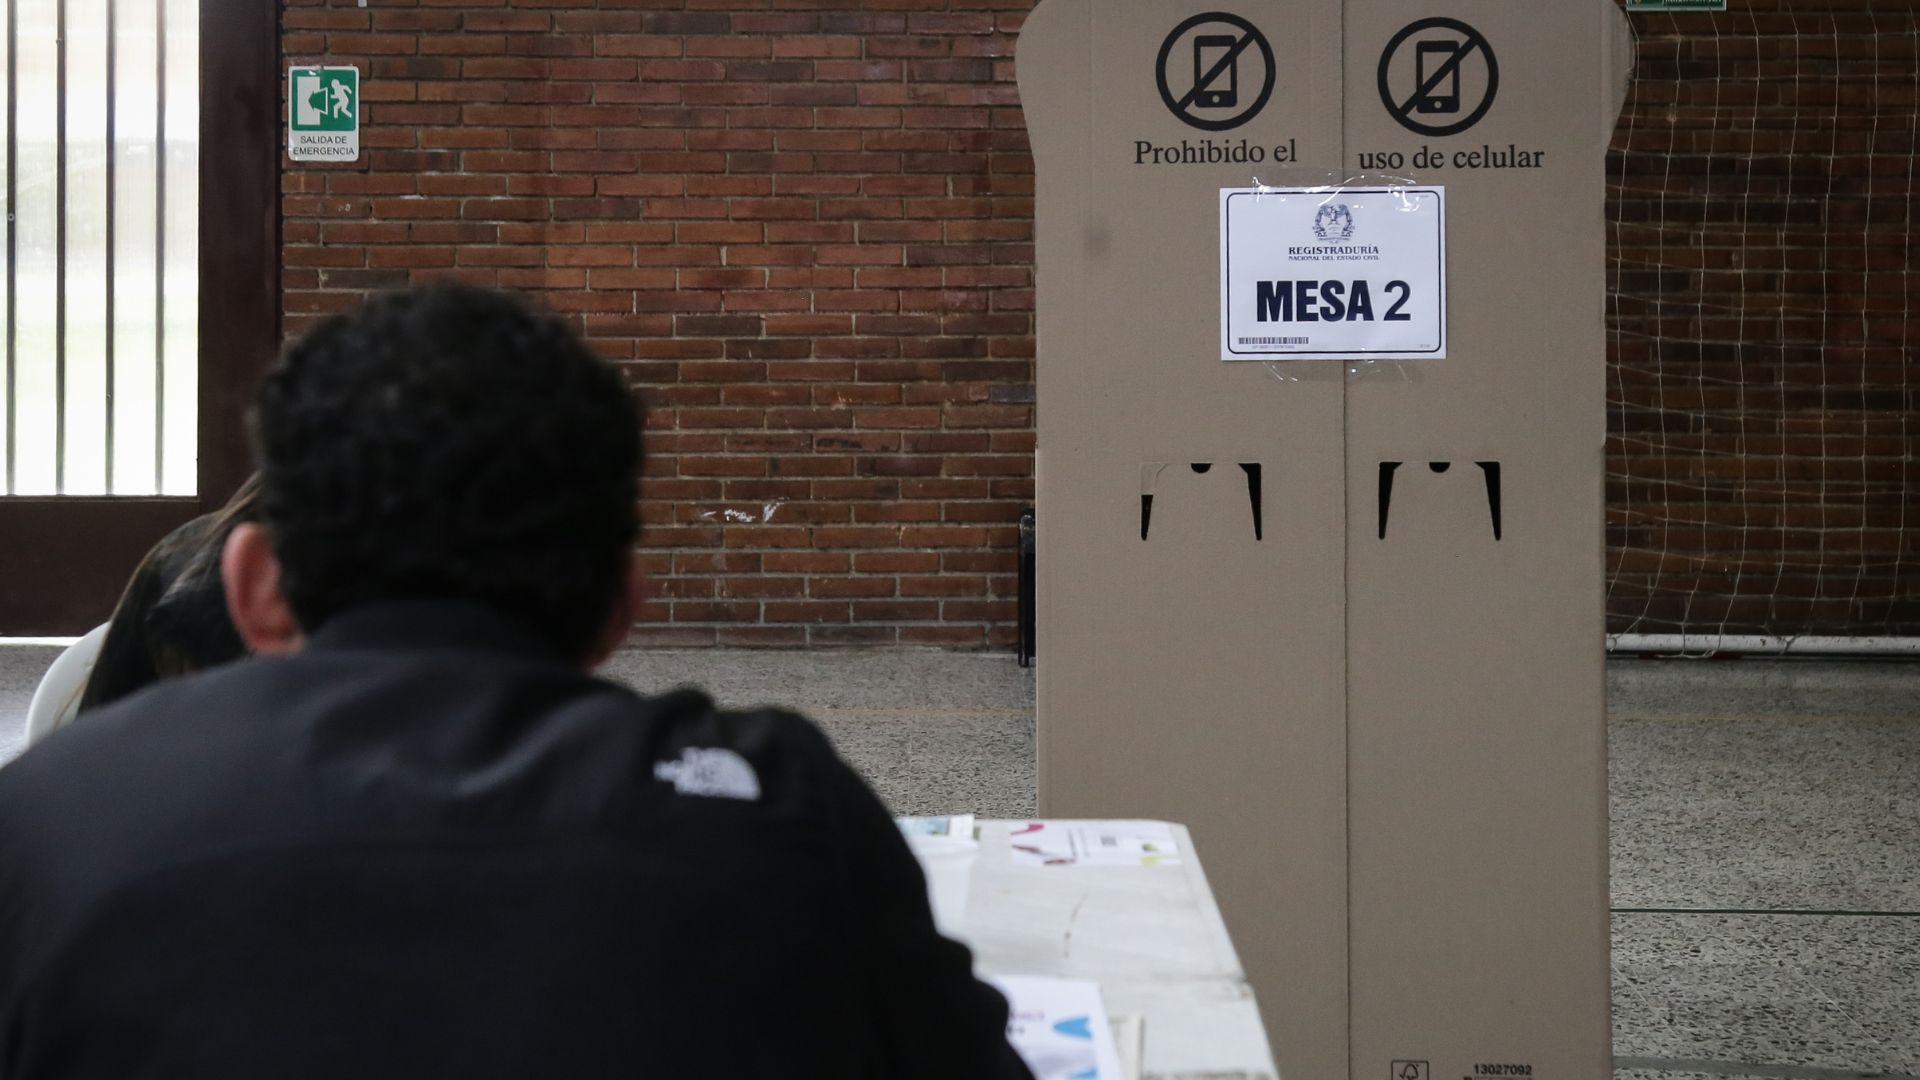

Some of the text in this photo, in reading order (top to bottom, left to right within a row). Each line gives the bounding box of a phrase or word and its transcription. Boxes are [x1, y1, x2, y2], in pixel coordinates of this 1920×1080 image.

[300, 135, 347, 144] SALIDA DE
[293, 146, 355, 155] EMERGENCIA
[1134, 138, 1297, 164] Prohibido el
[1358, 144, 1545, 170] uso de celular
[1288, 244, 1379, 255] REGISTRADURÍA
[1256, 280, 1412, 322] MESA 2
[1473, 1063, 1533, 1076] 13027092
